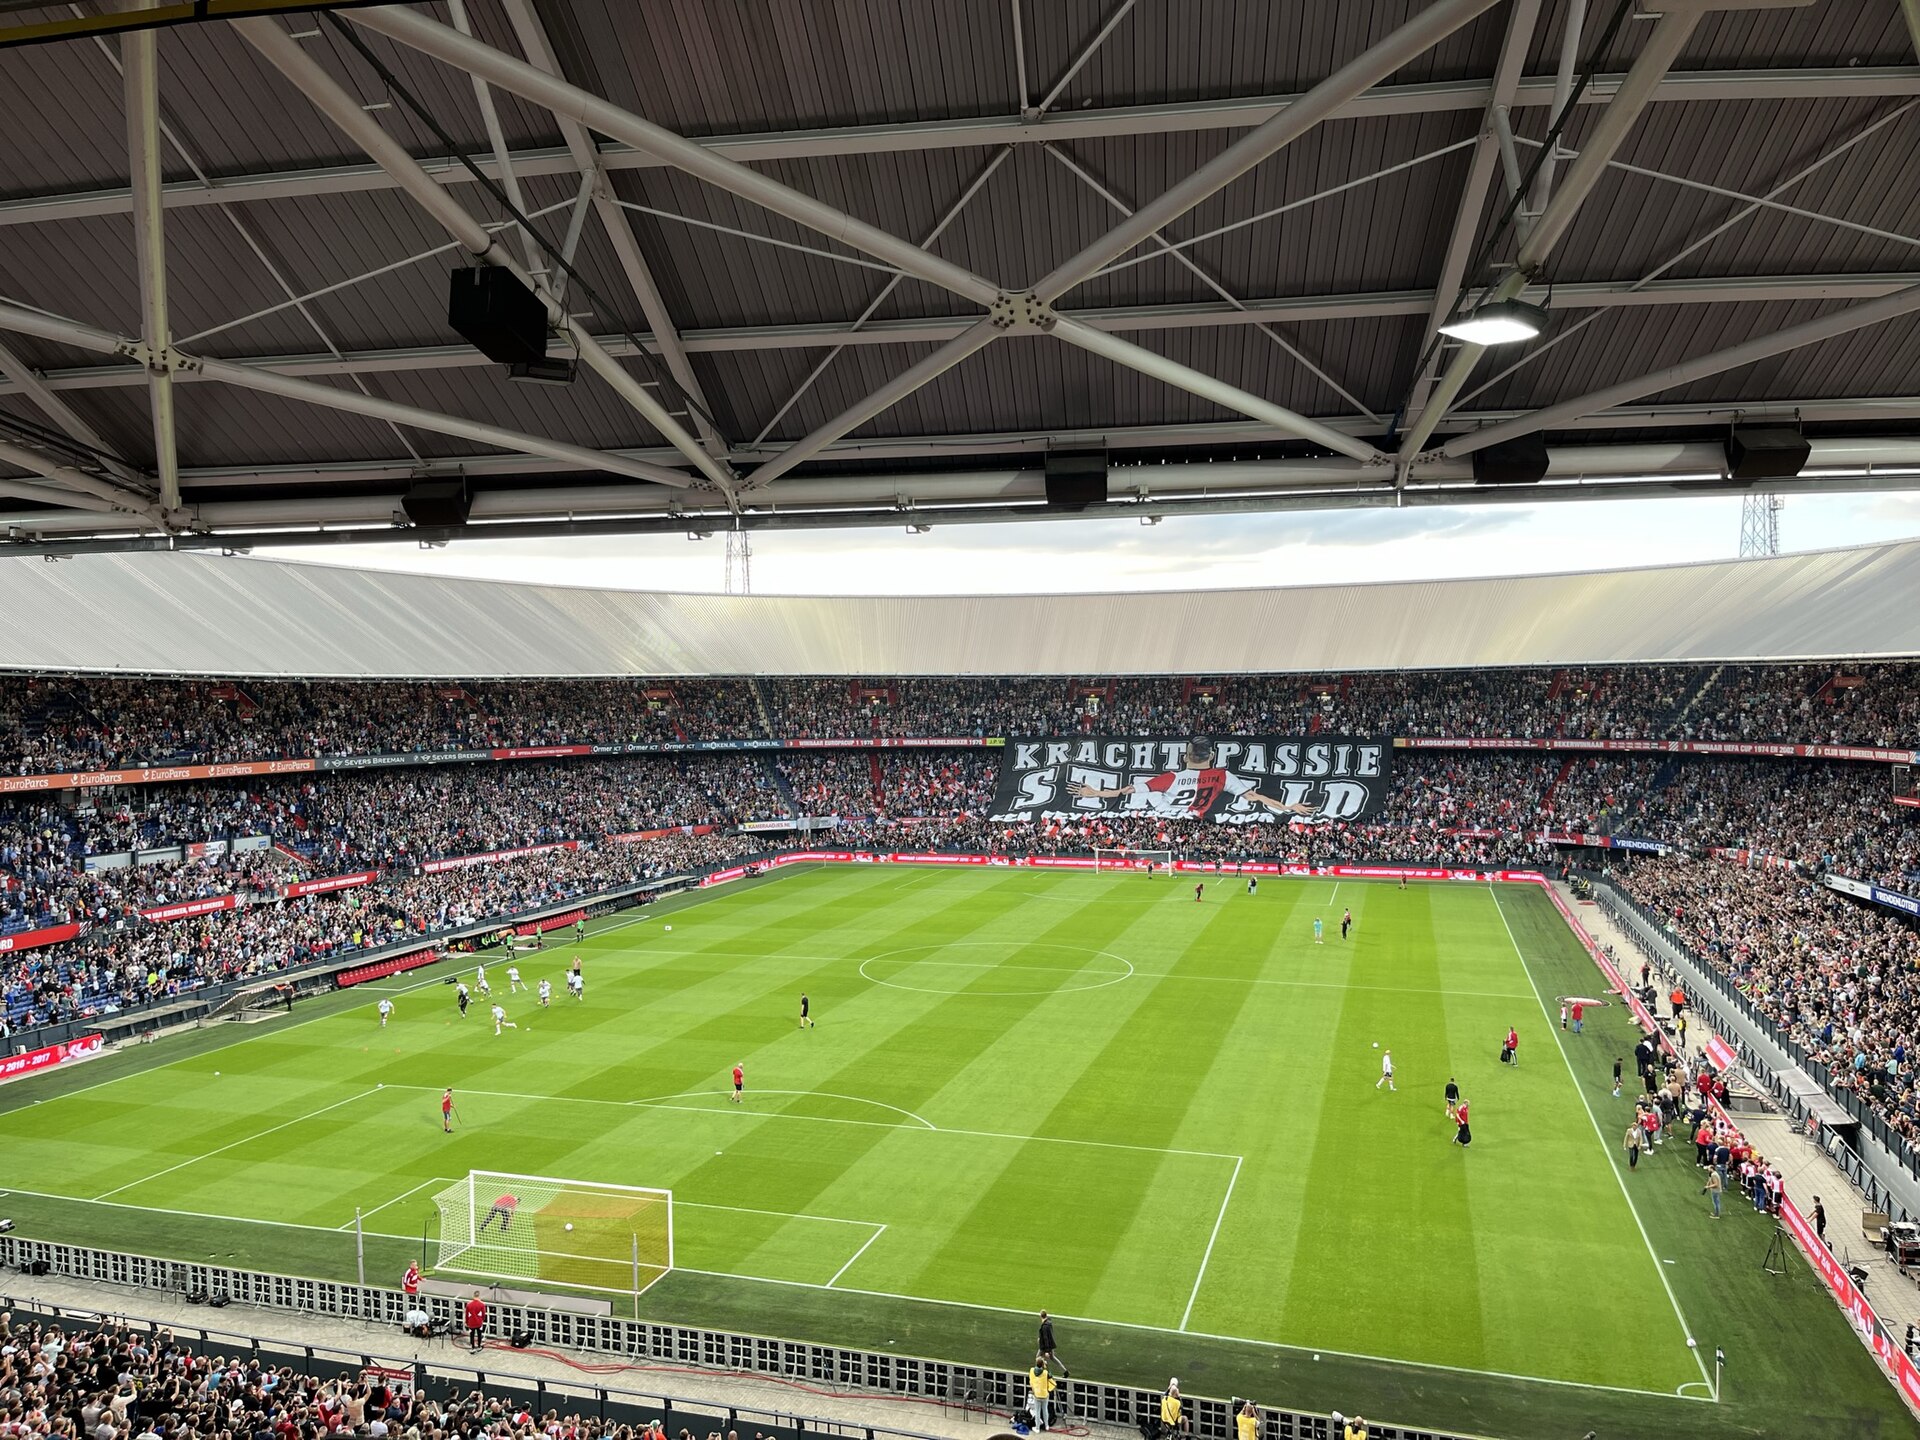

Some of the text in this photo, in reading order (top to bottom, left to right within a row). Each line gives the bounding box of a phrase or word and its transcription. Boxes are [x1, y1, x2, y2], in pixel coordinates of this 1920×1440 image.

[593, 744, 612, 753] Ormer
[627, 743, 648, 752] Ormer
[664, 742, 685, 750] Ormer
[344, 756, 405, 767] SEVERS BREEMAN
[432, 752, 487, 761] SEVERS BREEMAN
[1013, 741, 1382, 777] KRACHT PASSIE
[217, 765, 252, 775] EuroParcs
[277, 761, 311, 771] EuroParcs
[80, 773, 122, 785] EuroParcs
[151, 769, 190, 780] EuroParcs
[4, 778, 49, 790] EuroParcs
[5, 1059, 25, 1073] 2016
[32, 1052, 51, 1065] 2017
